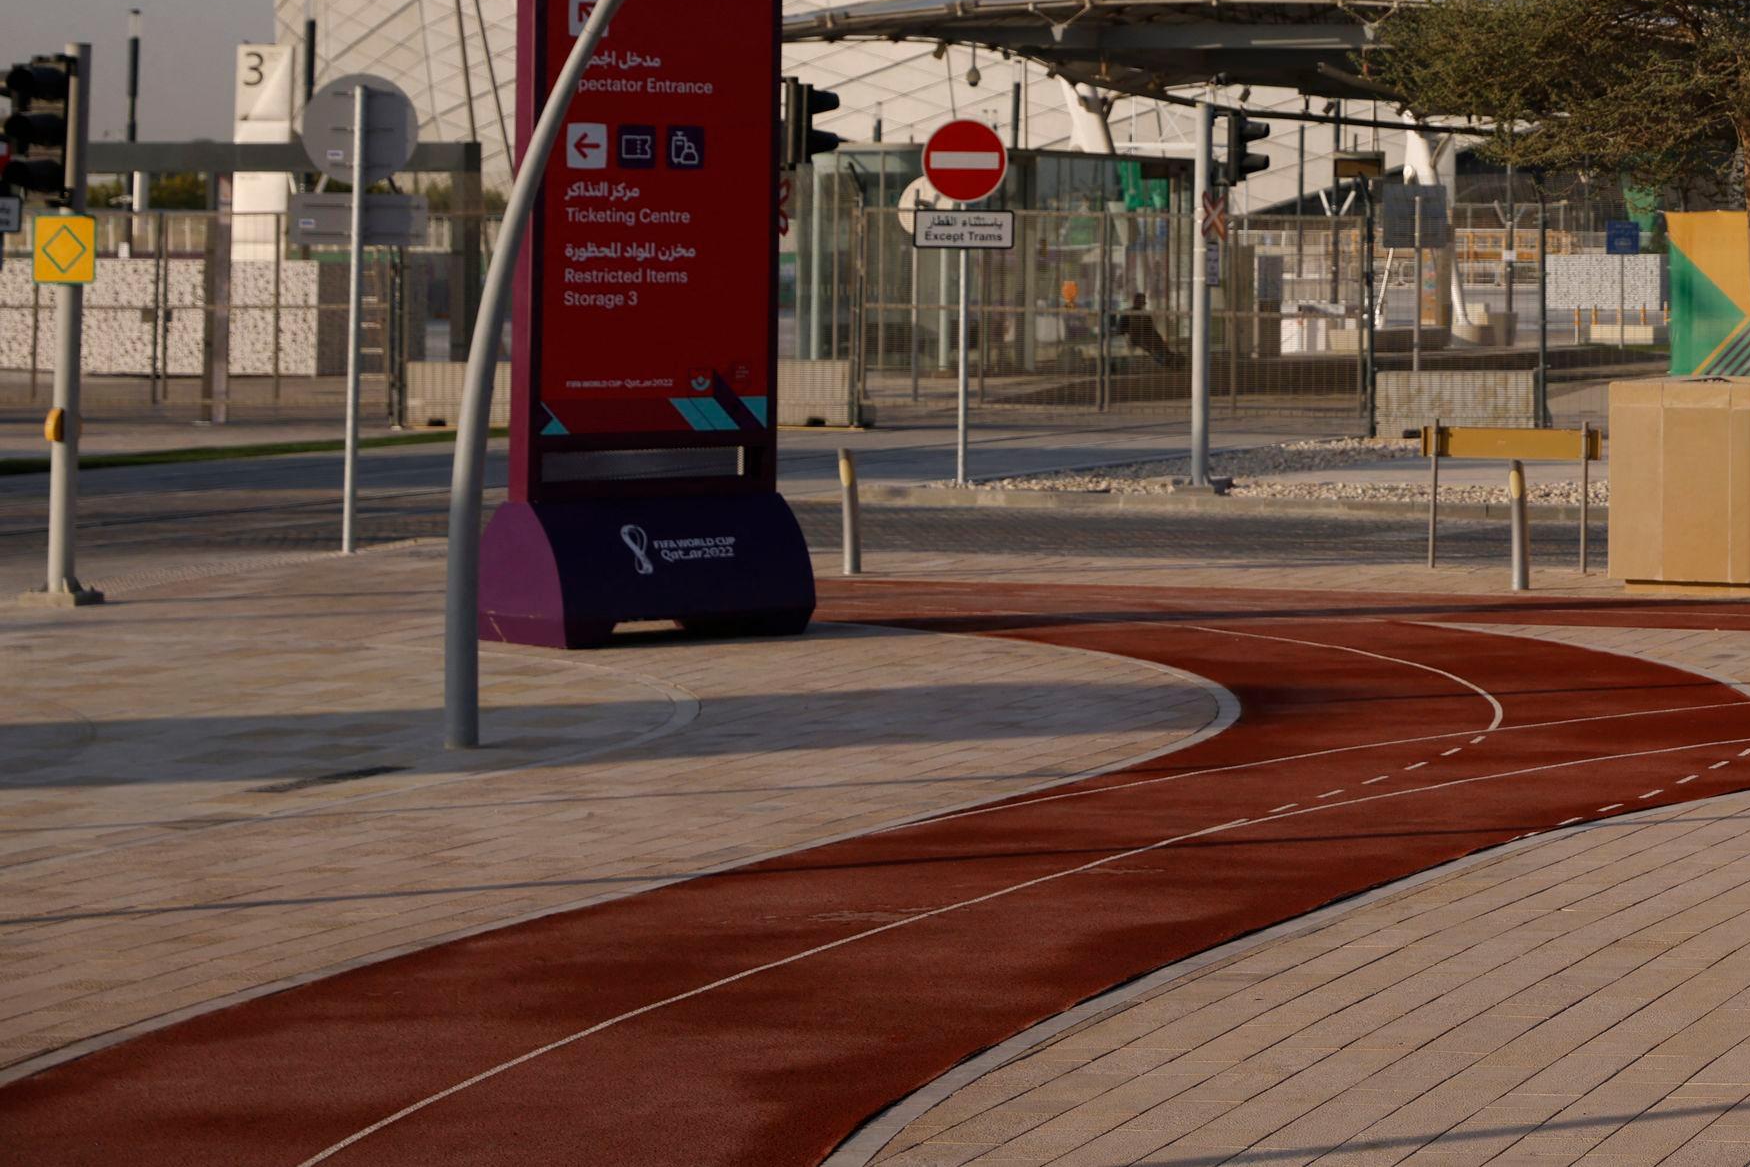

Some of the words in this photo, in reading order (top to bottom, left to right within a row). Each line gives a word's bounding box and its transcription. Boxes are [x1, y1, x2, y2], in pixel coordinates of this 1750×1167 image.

[243, 51, 263, 86] 3
[619, 51, 661, 69] مدخل
[578, 78, 643, 93] pectator
[646, 78, 713, 94] Entrance
[564, 182, 608, 200] التذاكر
[609, 182, 640, 201] مركز
[565, 207, 636, 226] Ticketing
[640, 208, 691, 224] Centre
[924, 231, 964, 243] Except
[967, 231, 1003, 241] Trams
[624, 242, 656, 261] المواد
[658, 243, 697, 261] مخزن
[564, 268, 642, 284] Restricted
[646, 268, 688, 284] Items
[564, 290, 624, 309] Storage
[627, 290, 638, 306] 3
[652, 539, 677, 549] FIFA
[676, 538, 714, 547] WORLD
[715, 536, 736, 546] CUP
